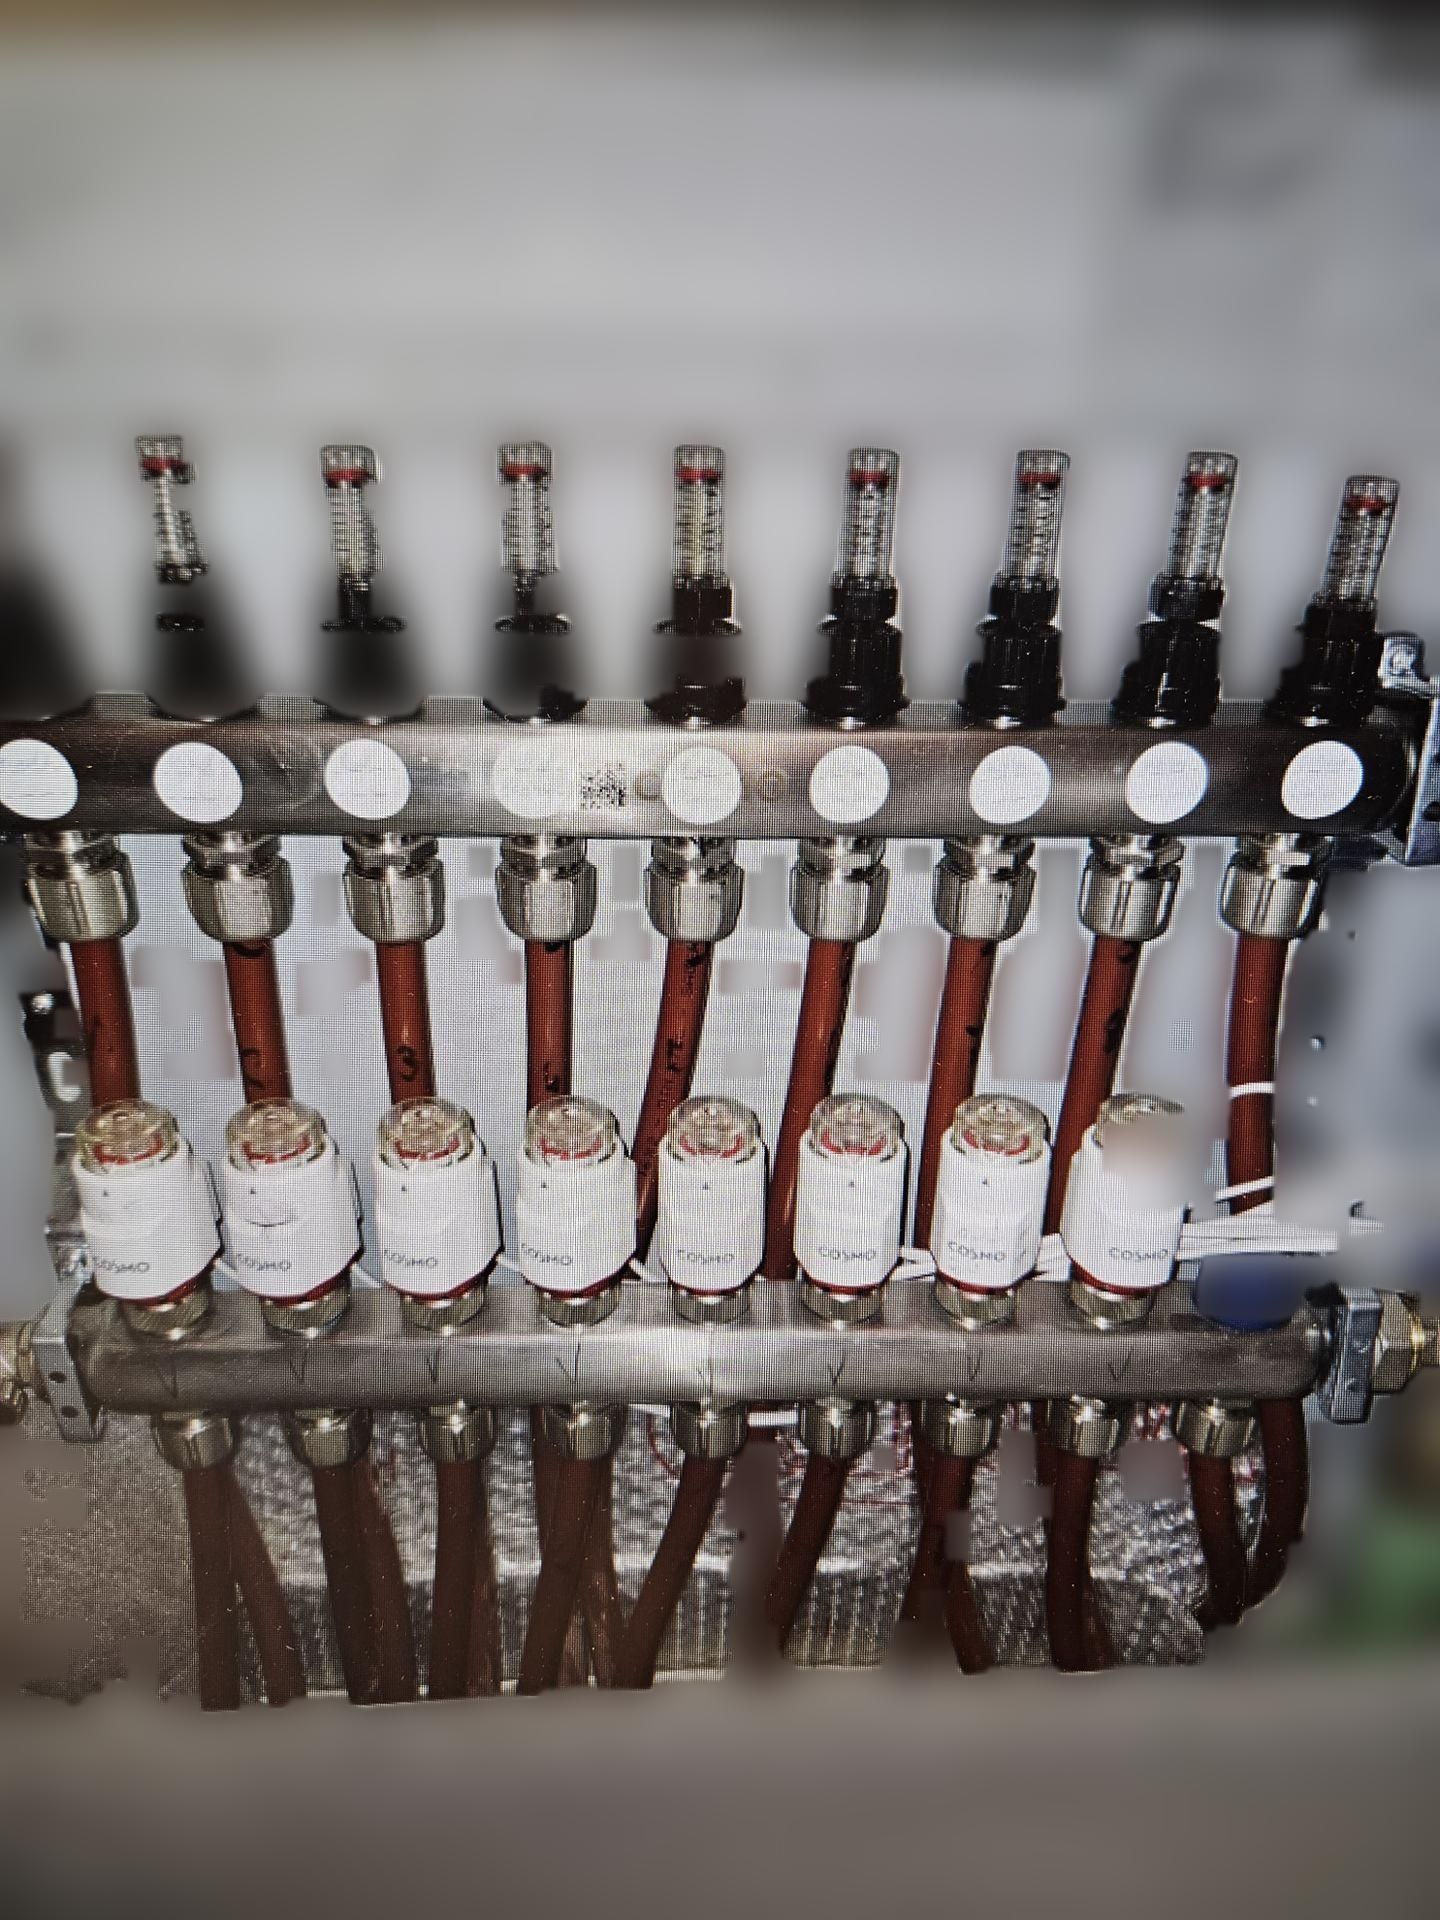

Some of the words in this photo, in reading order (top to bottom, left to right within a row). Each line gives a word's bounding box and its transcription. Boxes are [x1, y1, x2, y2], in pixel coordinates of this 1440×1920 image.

[396, 1045, 418, 1082] 3
[677, 1248, 735, 1266] COSMO
[818, 1245, 877, 1262] COSMO
[947, 1240, 1007, 1263] COSMO
[1108, 1246, 1169, 1262] COSMO
